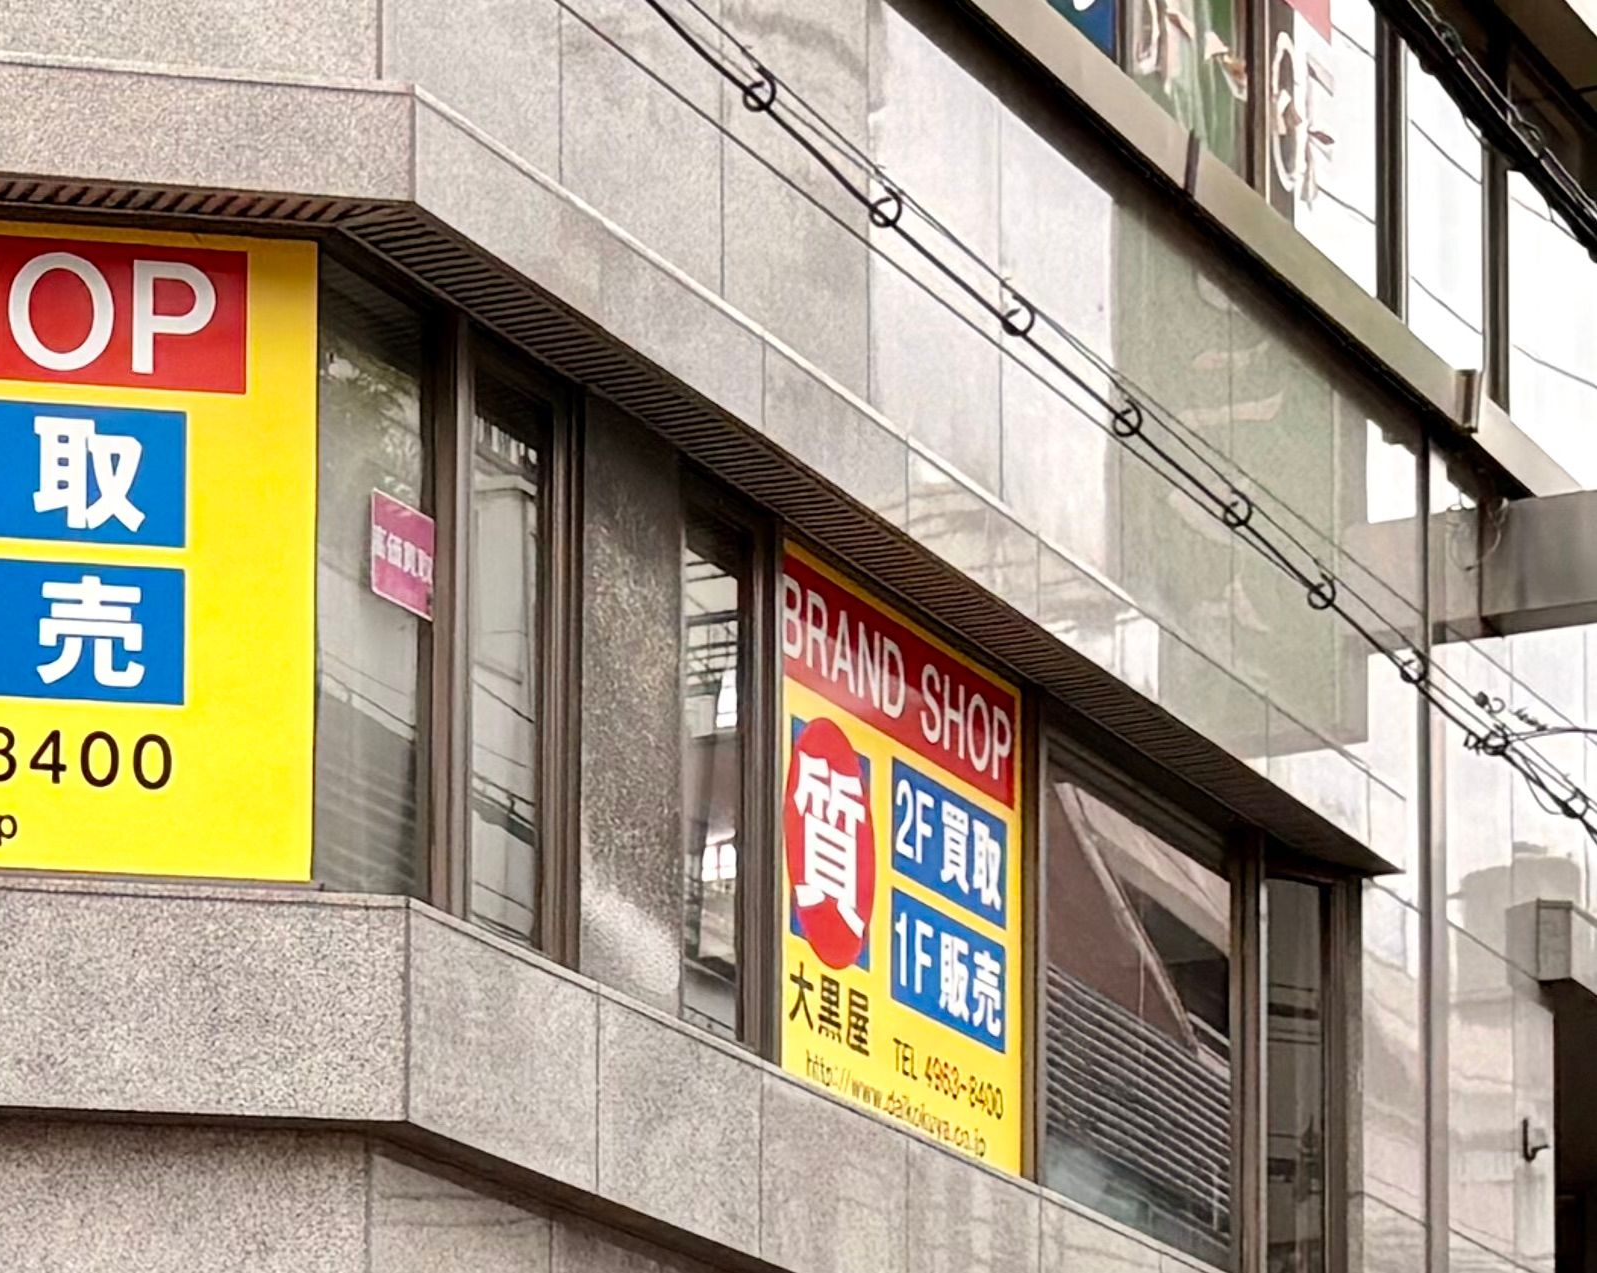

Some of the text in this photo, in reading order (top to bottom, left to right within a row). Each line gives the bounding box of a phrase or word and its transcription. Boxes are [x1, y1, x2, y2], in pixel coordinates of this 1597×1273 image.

[782, 573, 1011, 780] BRAND SHOP
[793, 750, 866, 938] 質
[789, 961, 870, 1057] 大黒屋
[893, 1037, 917, 1081] TEL
